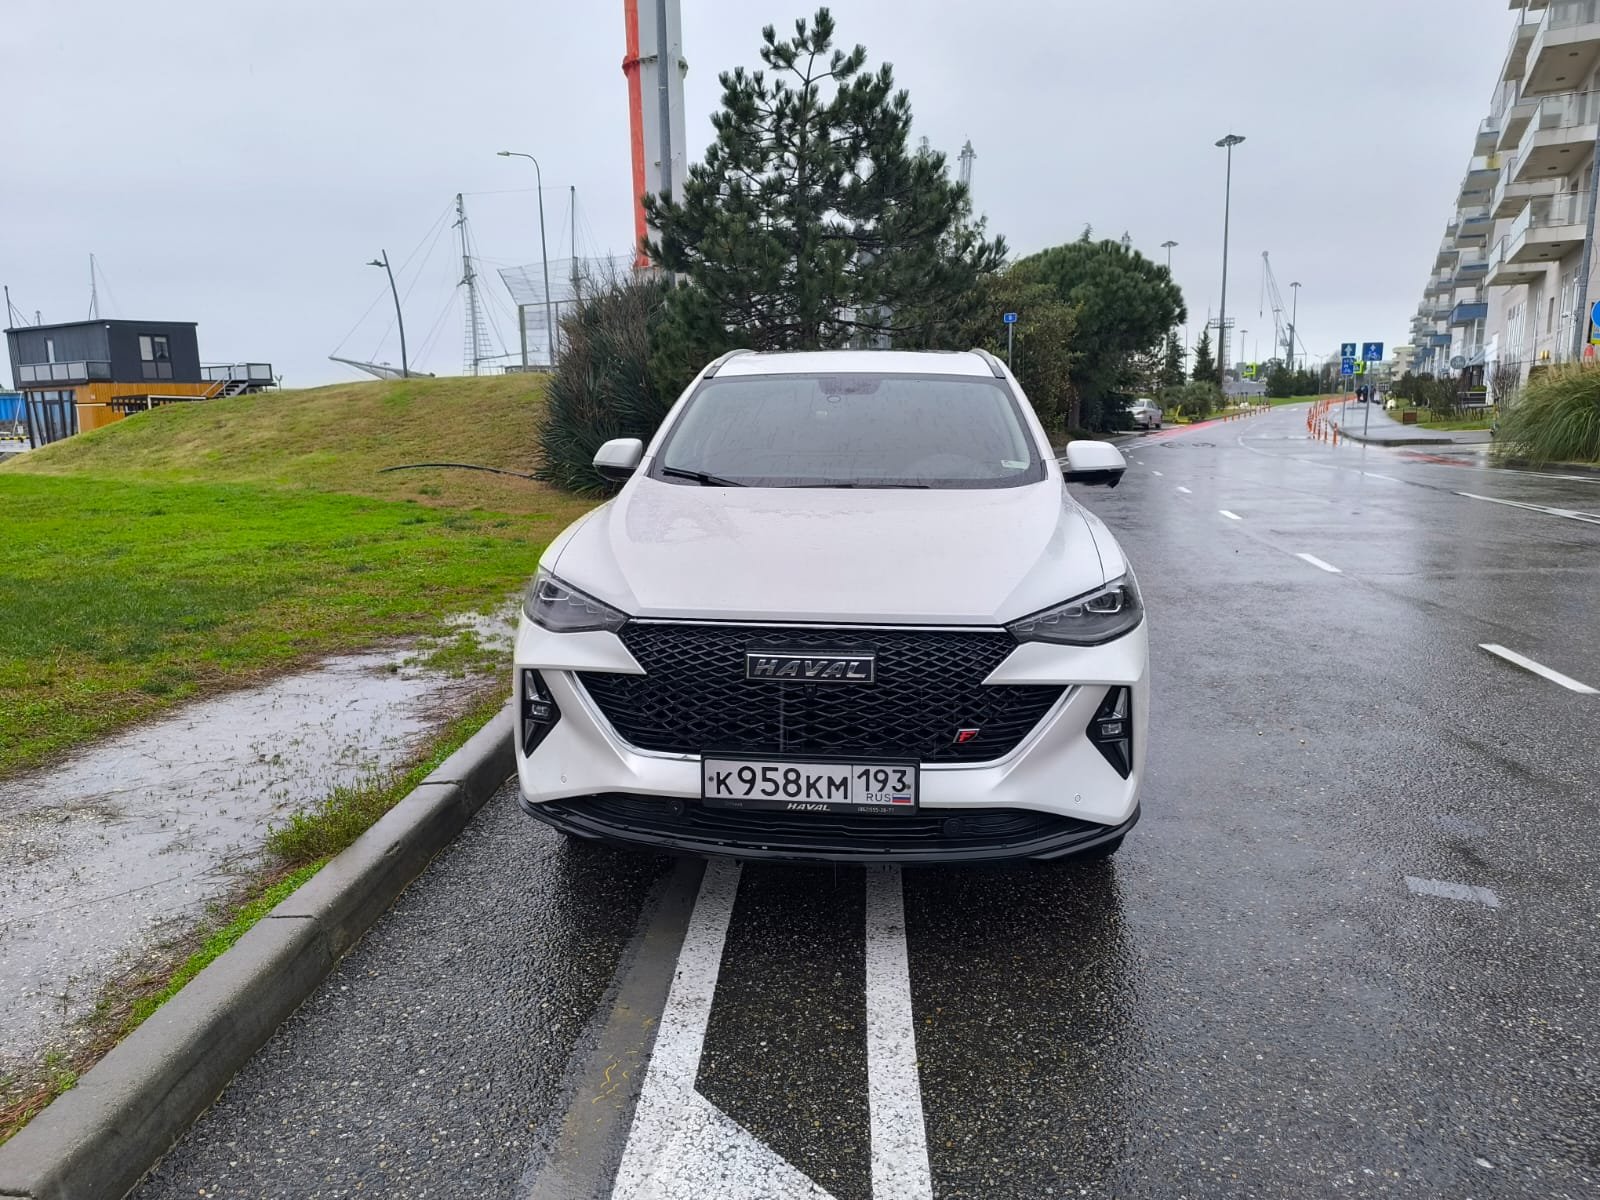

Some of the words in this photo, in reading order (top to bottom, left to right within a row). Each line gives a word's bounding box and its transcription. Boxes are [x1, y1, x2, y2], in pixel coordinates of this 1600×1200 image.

[753, 658, 867, 678] HAVAL
[857, 768, 907, 793] 193
[866, 793, 892, 803] RUS
[787, 802, 831, 811] HAVAL
